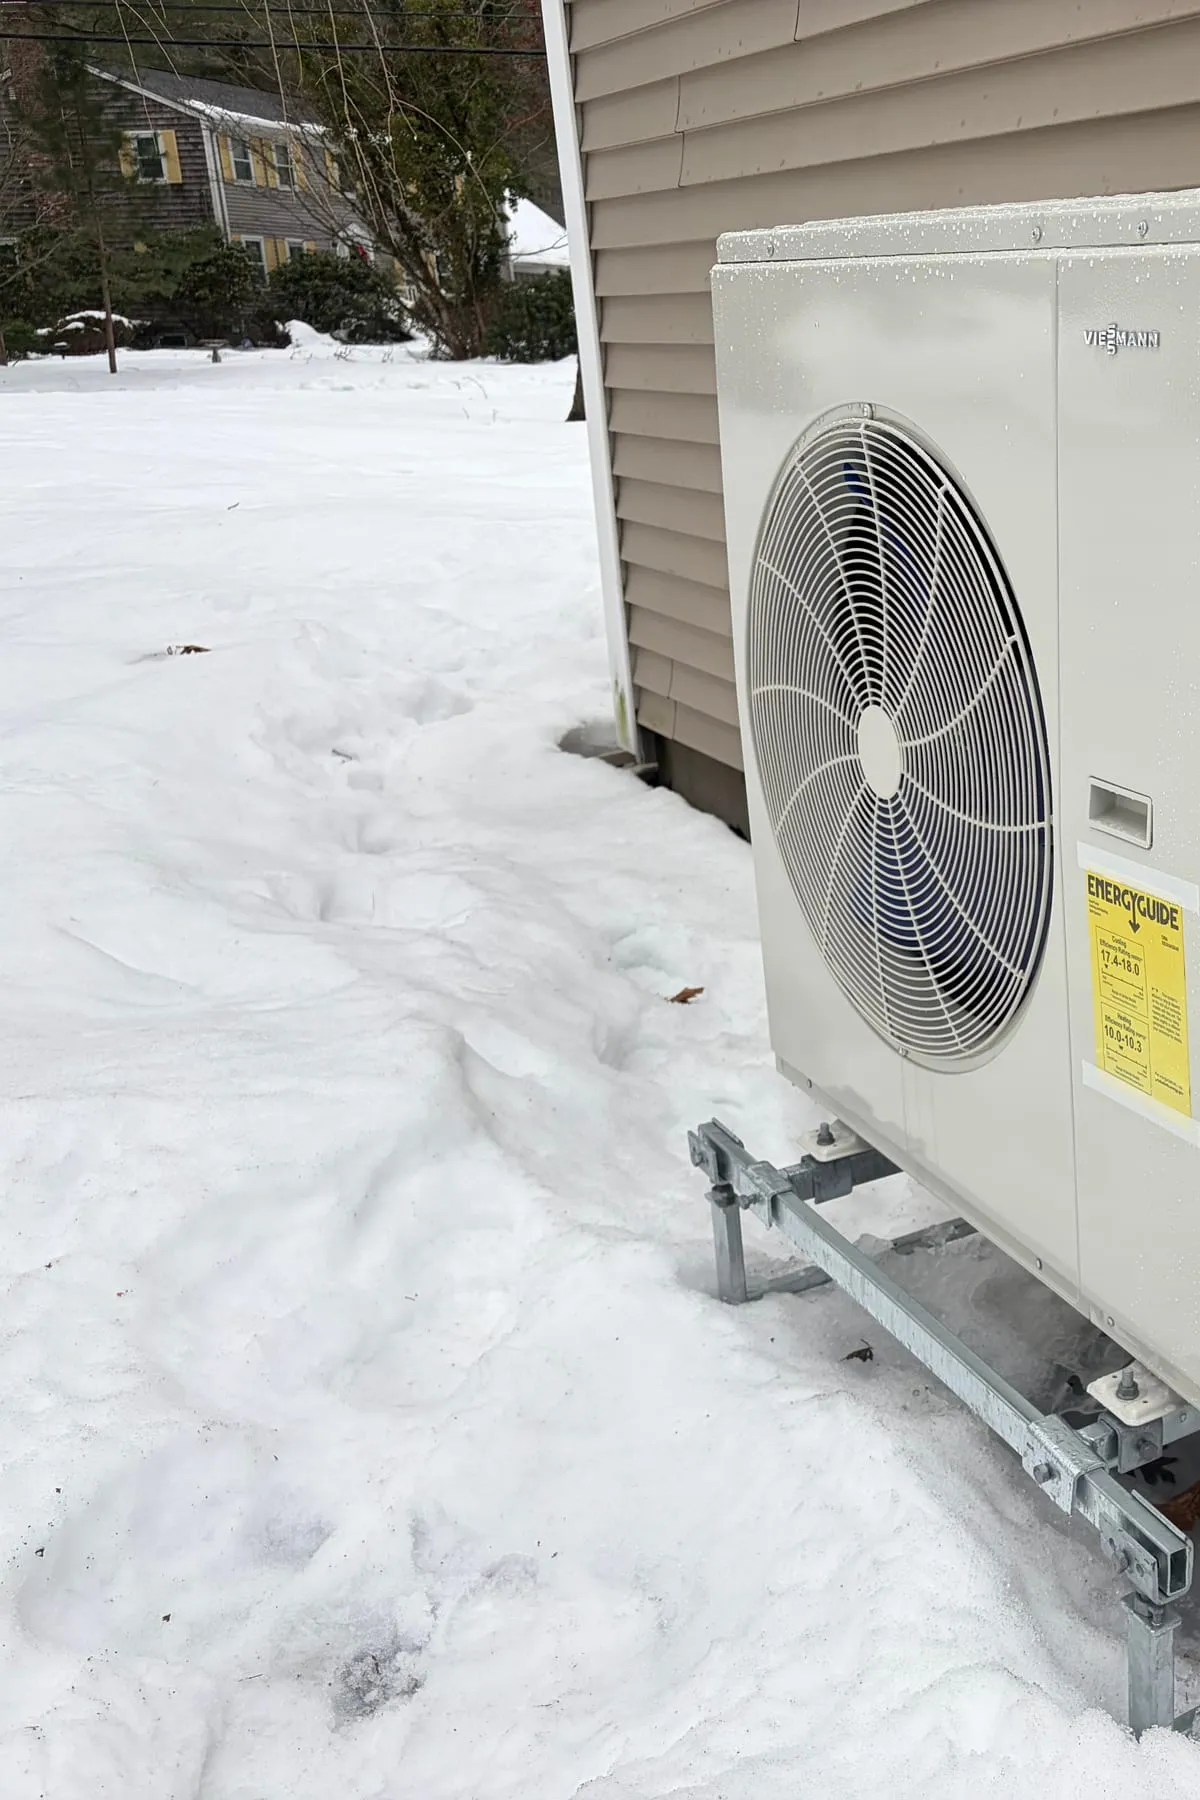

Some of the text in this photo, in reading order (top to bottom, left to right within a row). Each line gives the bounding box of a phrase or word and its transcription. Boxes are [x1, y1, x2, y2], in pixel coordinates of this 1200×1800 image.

[1083, 323, 1159, 355] VIESSMANN
[1087, 874, 1179, 932] ENERGYGUIDE
[1099, 938, 1118, 953] Efficiency
[1118, 946, 1131, 959] Rating
[1111, 935, 1127, 949] Cooling
[1101, 949, 1140, 976] 17.4-18.0
[1104, 1014, 1123, 1029] Efficiency
[1123, 1023, 1136, 1036] Rating
[1117, 1013, 1132, 1026] Heating
[1104, 1024, 1142, 1053] 10.0-10.3
